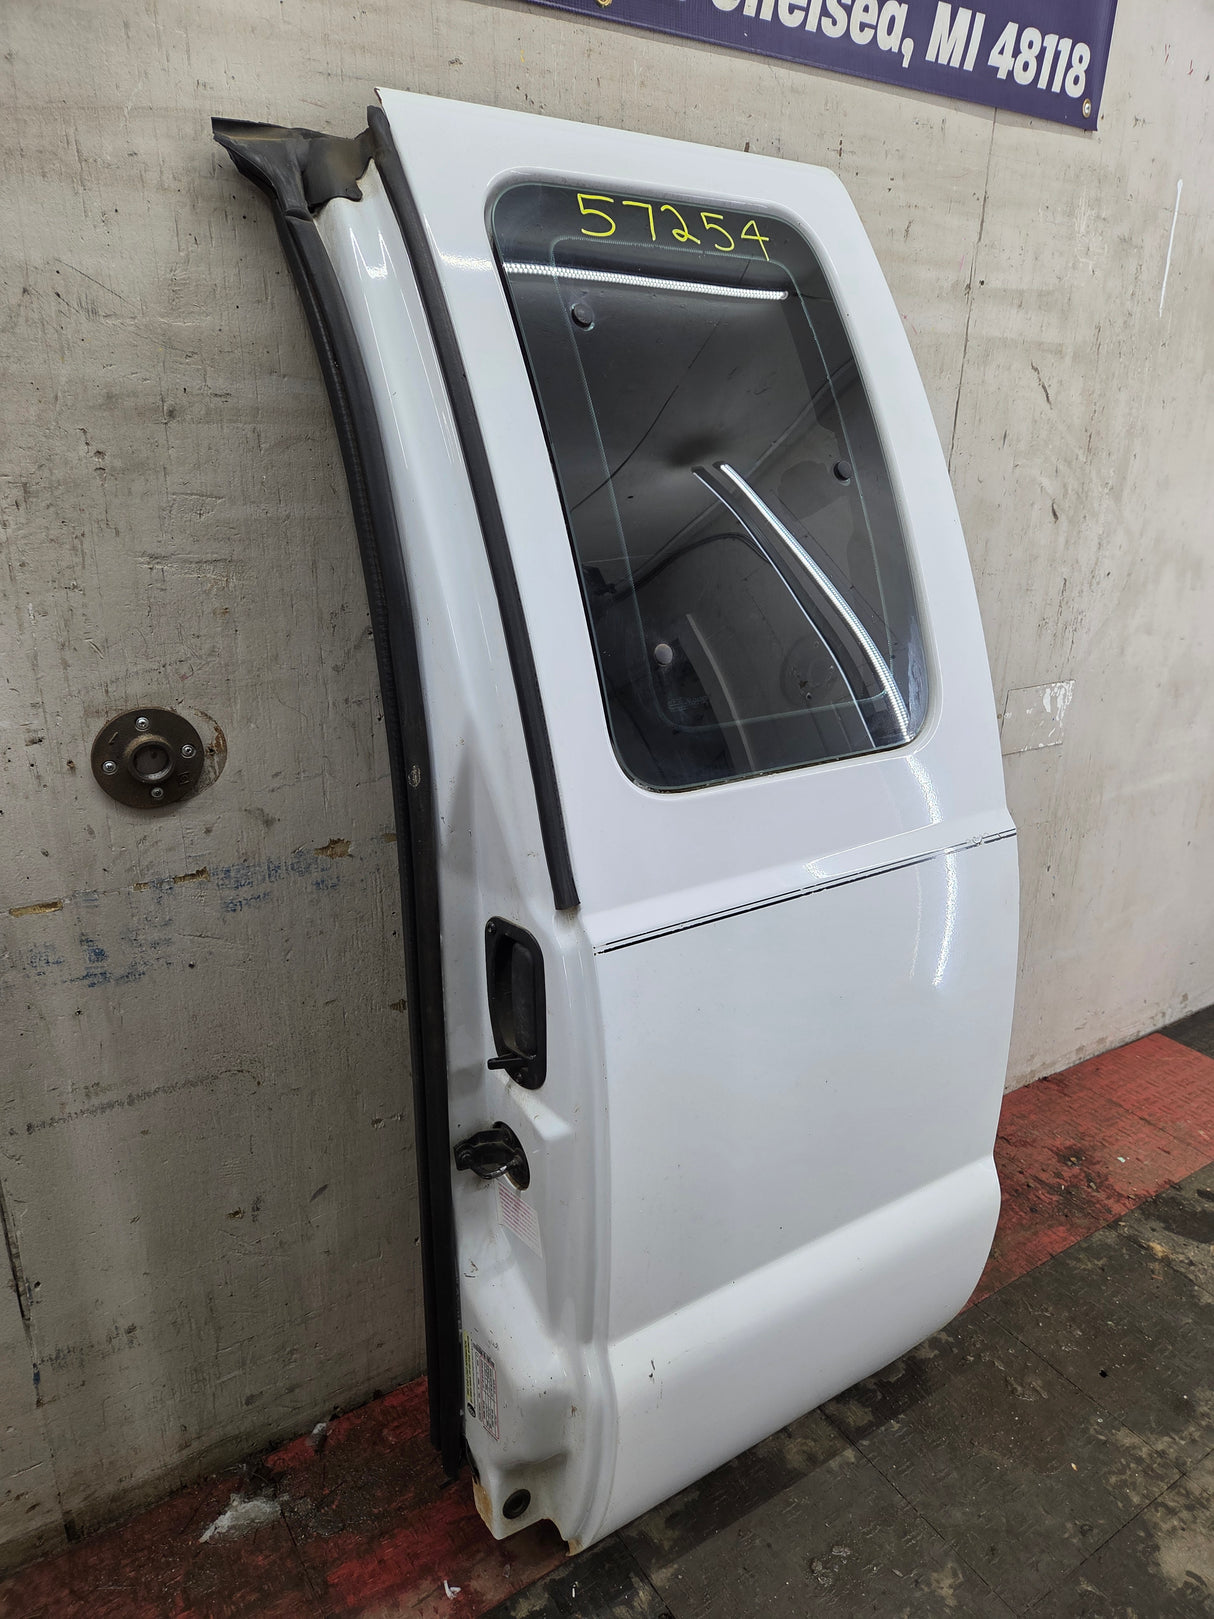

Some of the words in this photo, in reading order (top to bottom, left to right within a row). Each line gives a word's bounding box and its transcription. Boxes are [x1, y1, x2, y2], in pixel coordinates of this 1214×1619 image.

[711, 0, 915, 68] esea,
[925, 1, 986, 71] MI
[987, 21, 1091, 98] 48118
[577, 193, 770, 261] 57254
